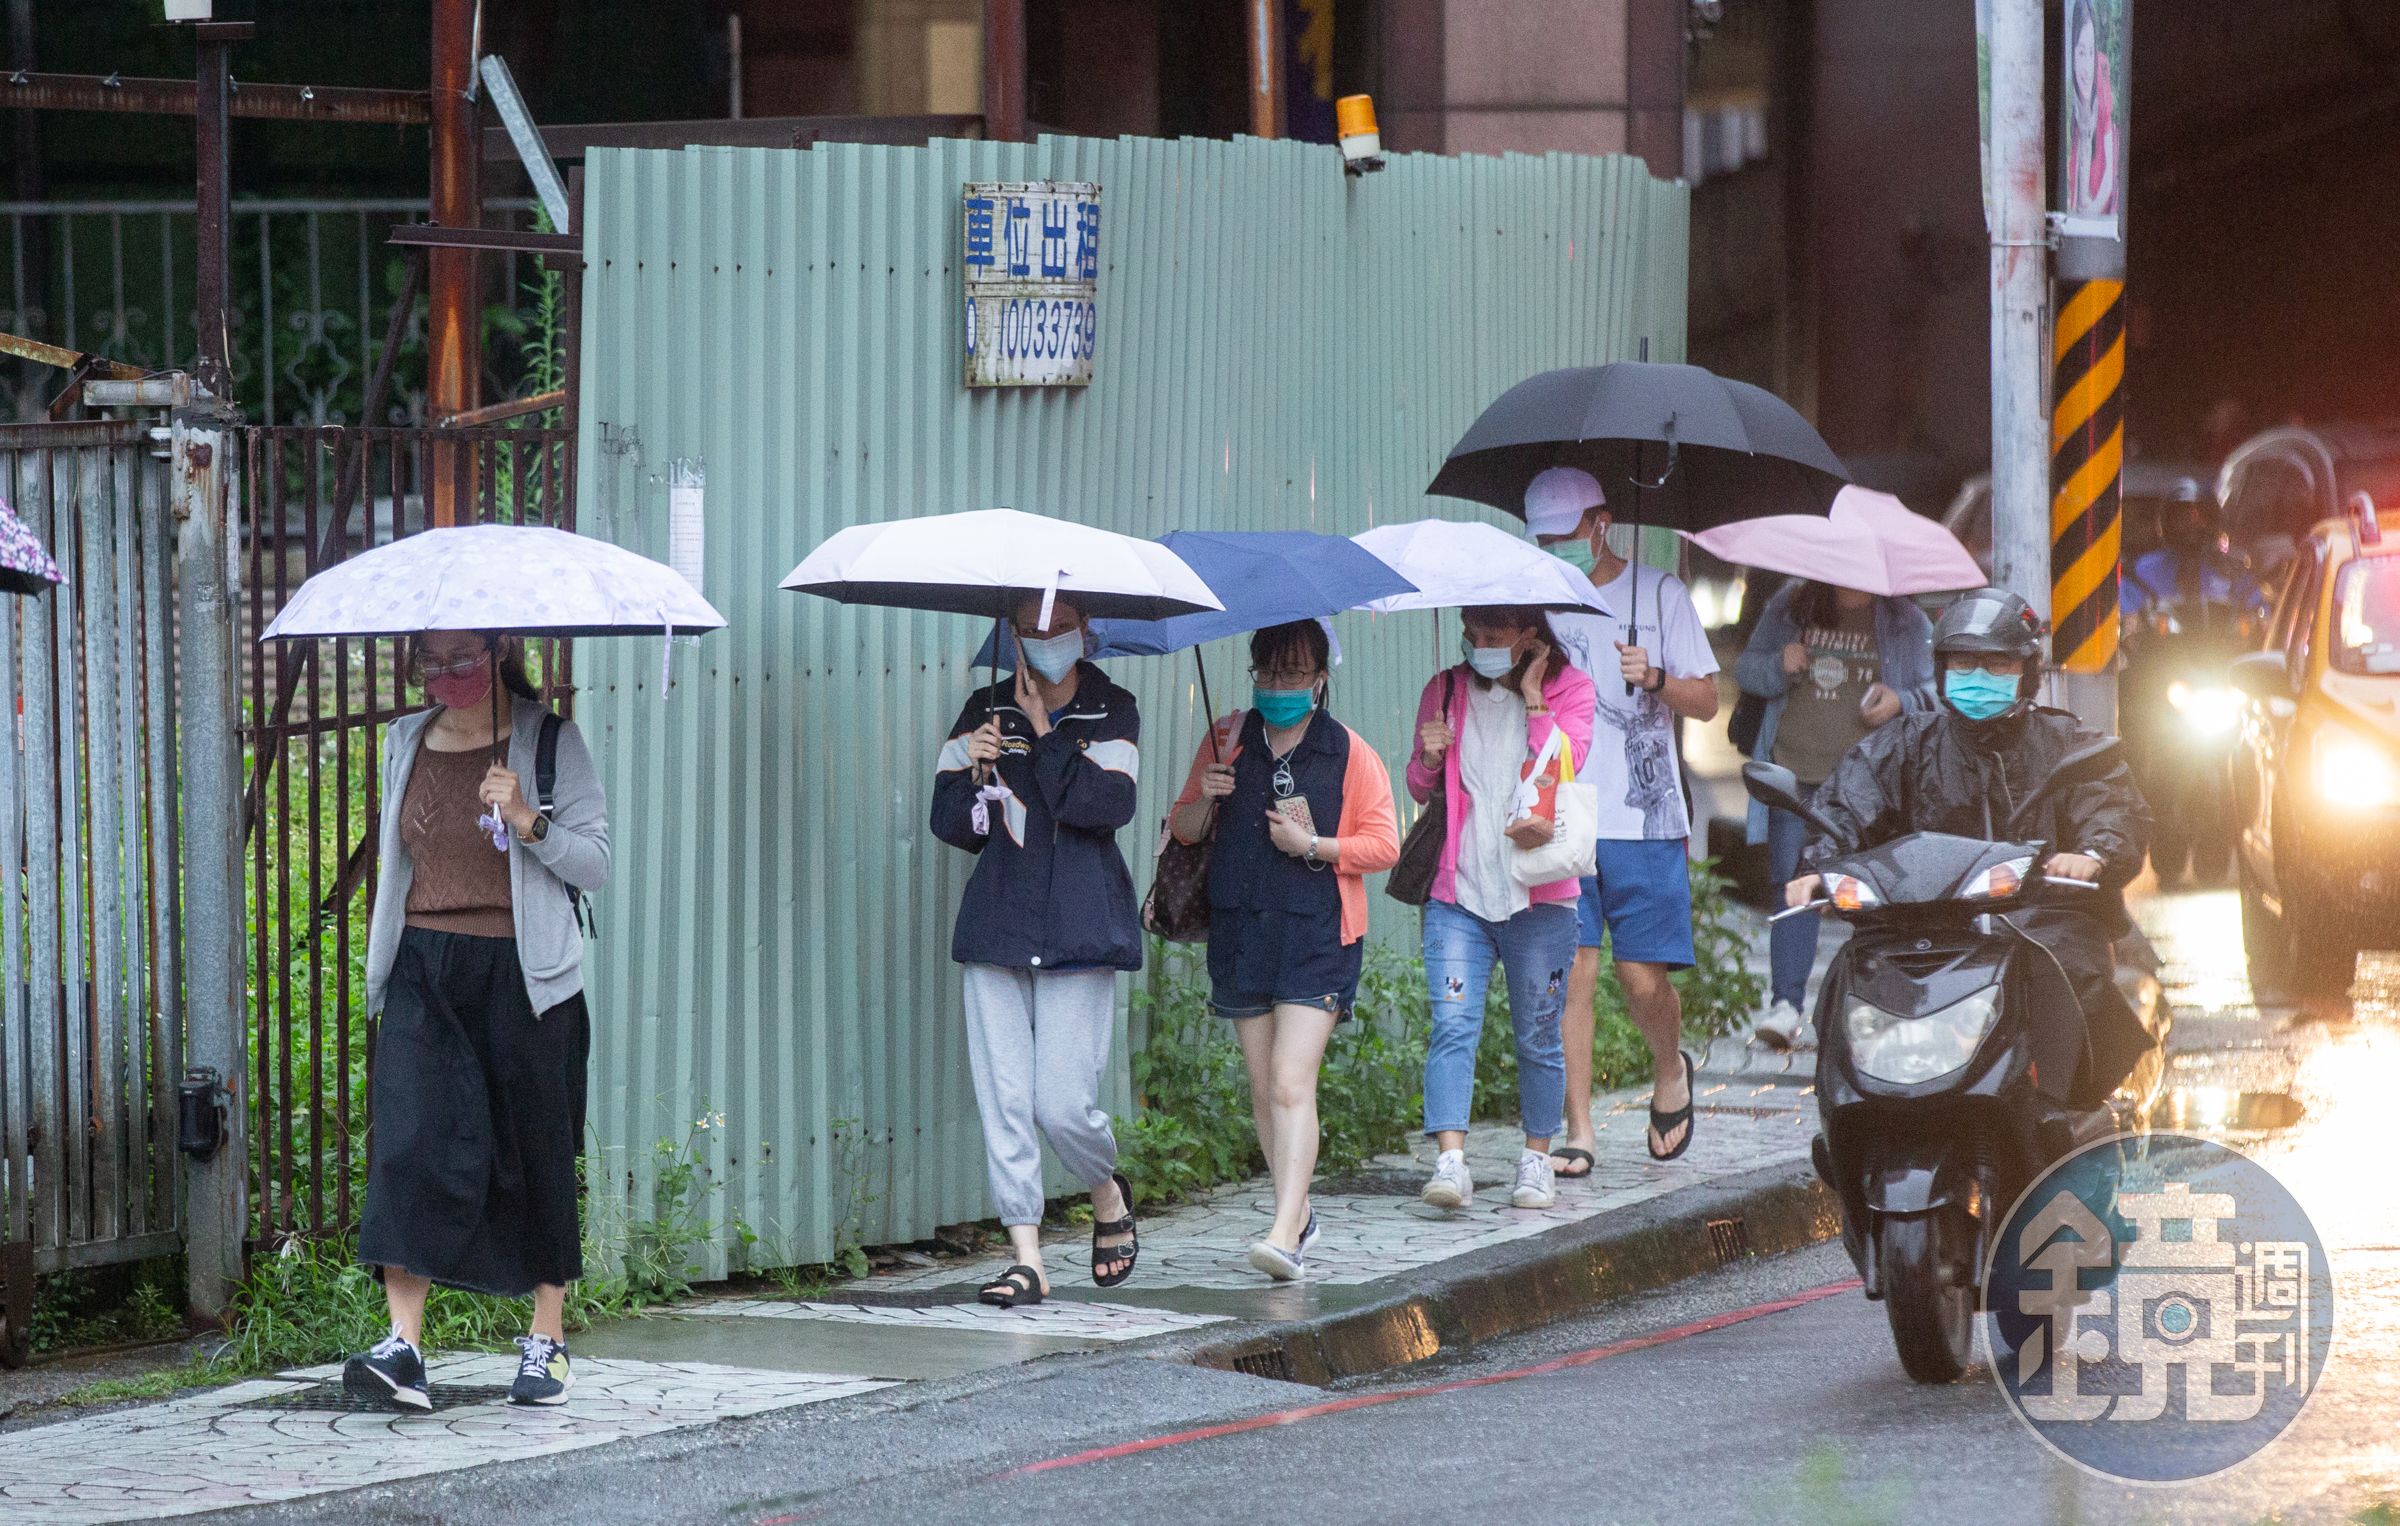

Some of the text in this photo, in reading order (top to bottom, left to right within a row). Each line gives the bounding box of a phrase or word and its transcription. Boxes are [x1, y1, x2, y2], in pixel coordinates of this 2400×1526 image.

[966, 194, 1099, 281] 車位出租
[966, 296, 1096, 361] 010033739
[1634, 757, 1655, 790] 10
